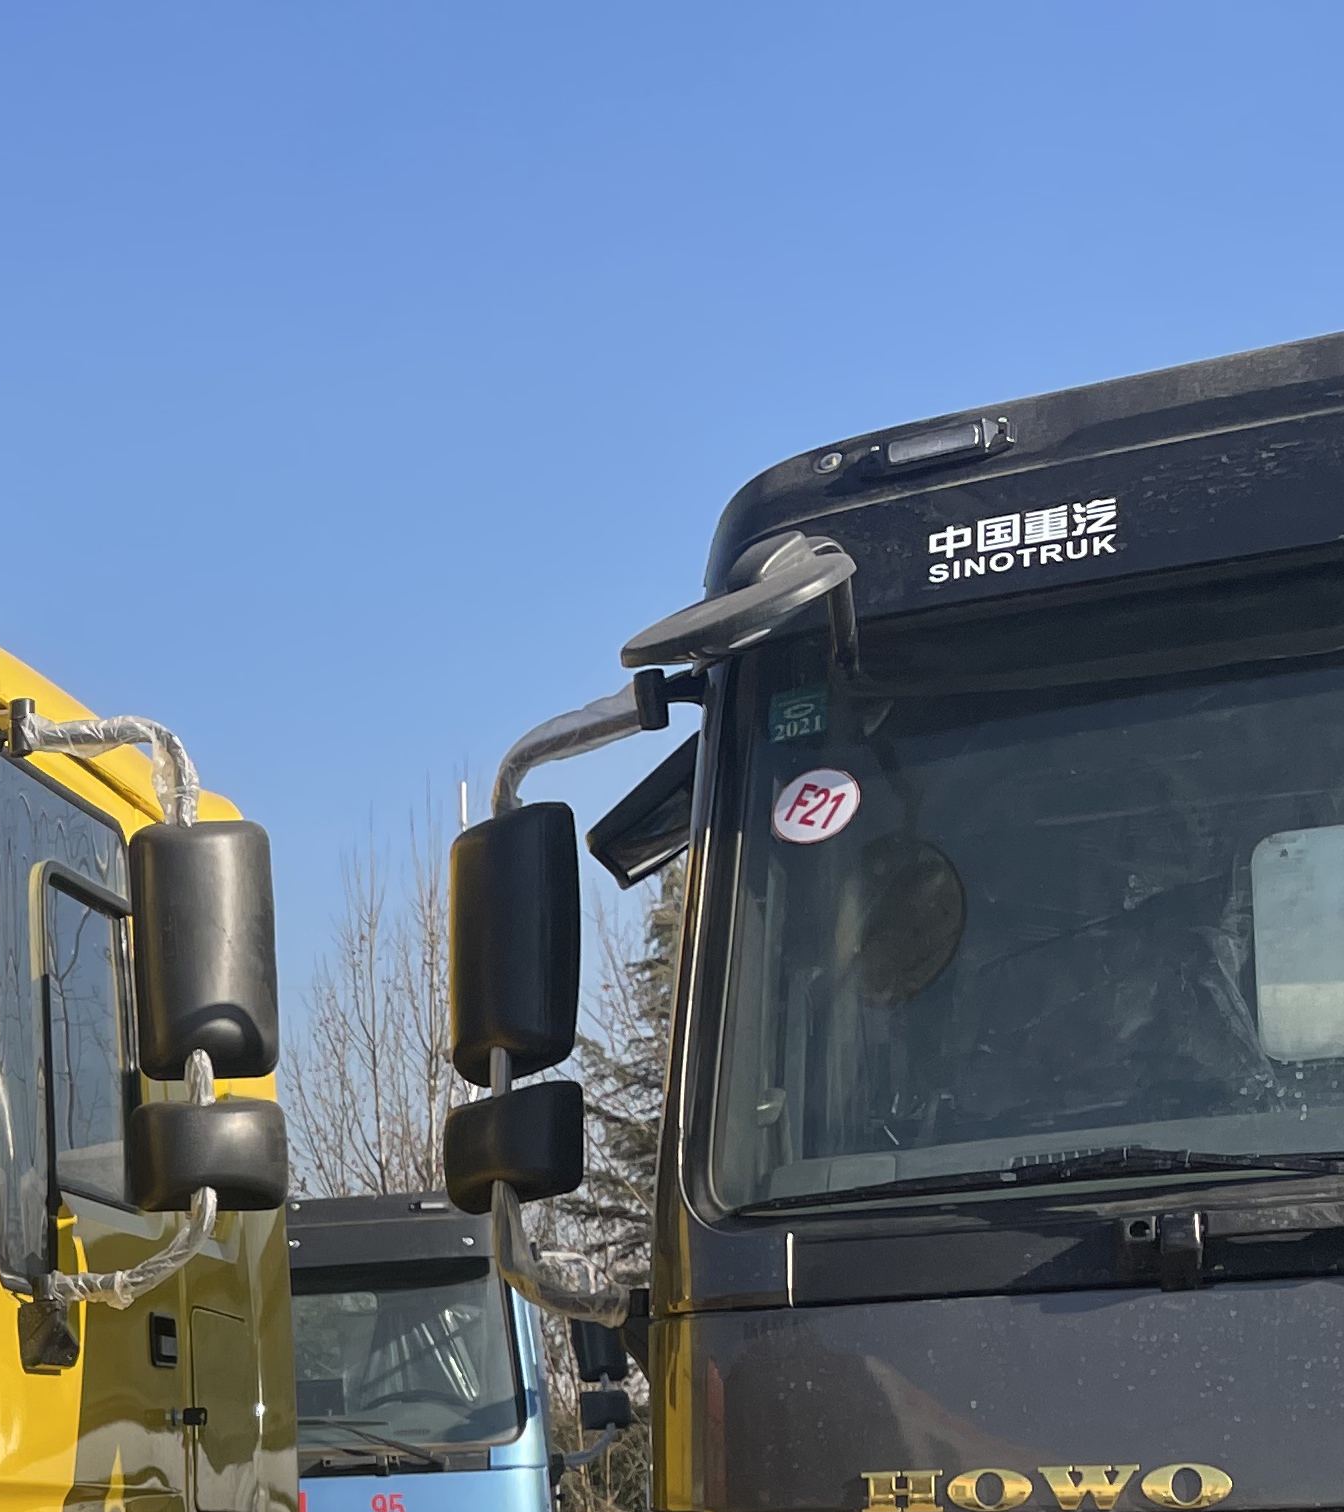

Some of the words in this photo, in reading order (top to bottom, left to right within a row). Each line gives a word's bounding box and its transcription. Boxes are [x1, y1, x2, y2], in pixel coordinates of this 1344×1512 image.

[928, 497, 1117, 558] 中国重汽
[928, 533, 1118, 584] SINOTRUK
[774, 715, 823, 741] 2021
[784, 783, 846, 830] F21
